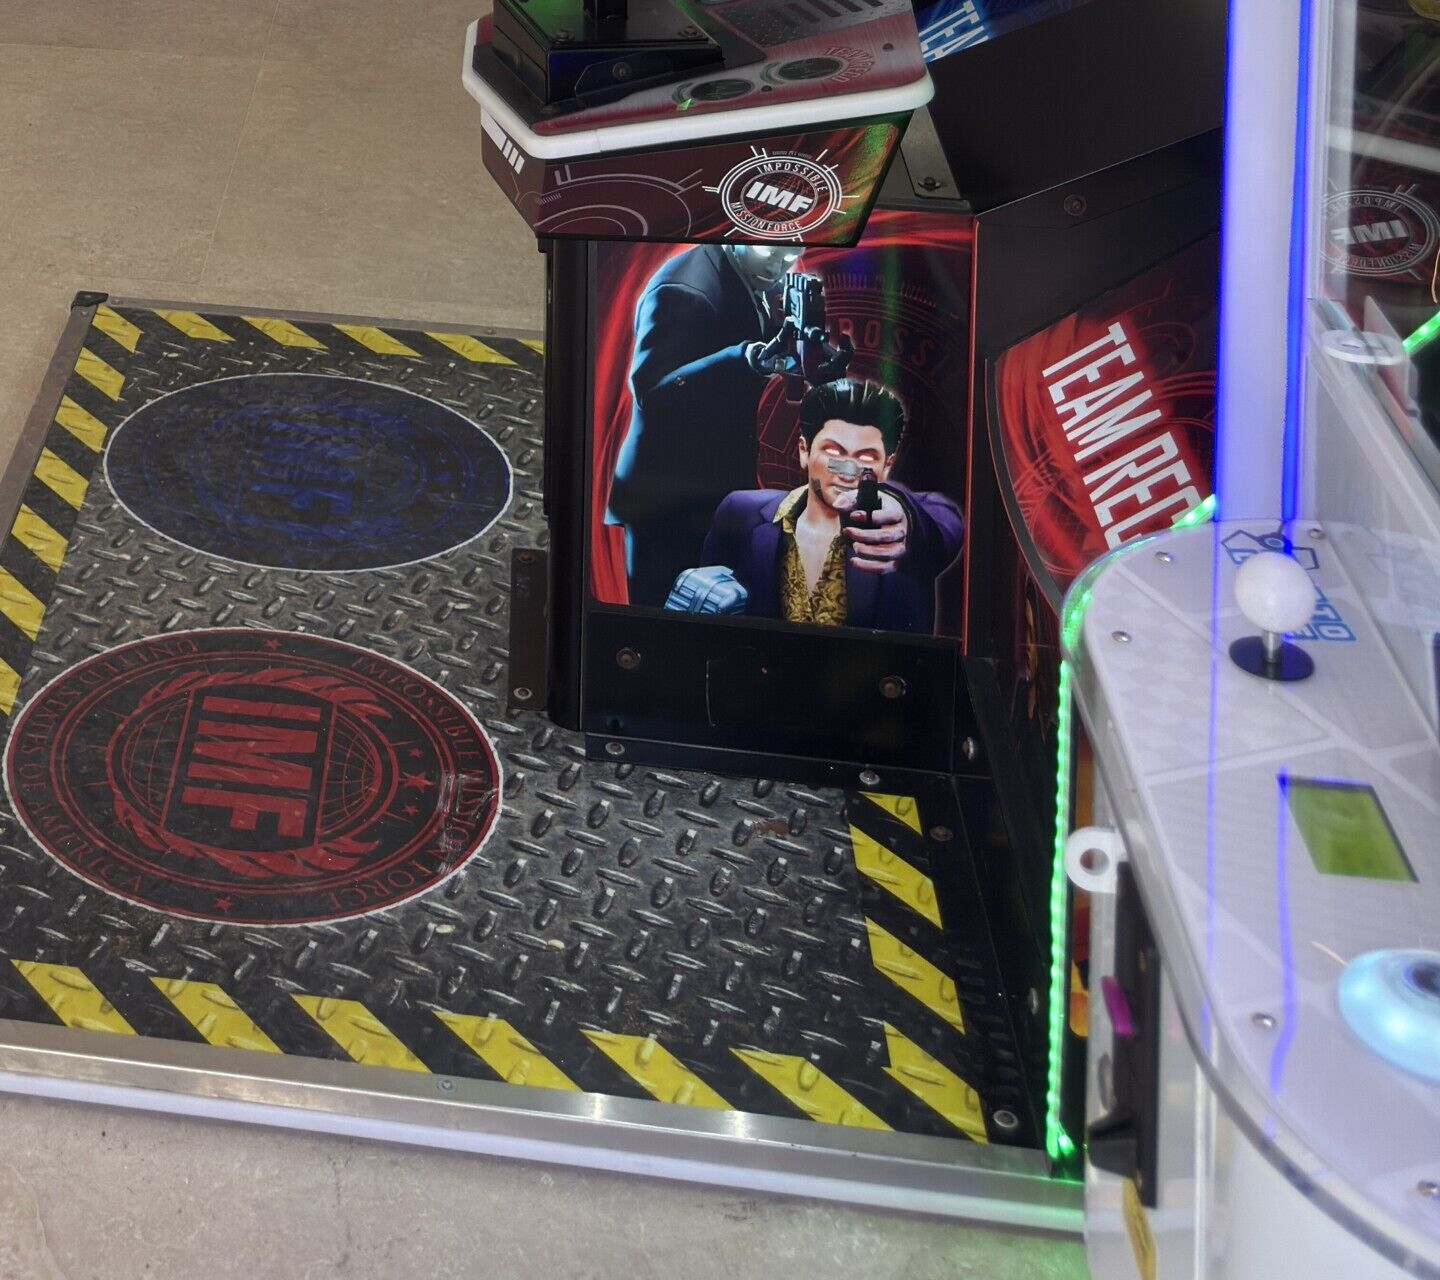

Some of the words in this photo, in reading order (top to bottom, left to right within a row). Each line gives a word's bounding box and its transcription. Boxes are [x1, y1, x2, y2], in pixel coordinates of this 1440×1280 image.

[746, 181, 814, 213] IMF
[757, 162, 828, 192] IMPOSSIBLE
[730, 201, 765, 230] MISSION
[766, 220, 803, 232] FORCE
[1042, 321, 1162, 462] TEAM
[79, 639, 199, 686] UNITED
[20, 689, 81, 755] STATES
[19, 763, 47, 792] OF
[180, 695, 322, 838] IMF
[30, 801, 143, 894] AMERICA
